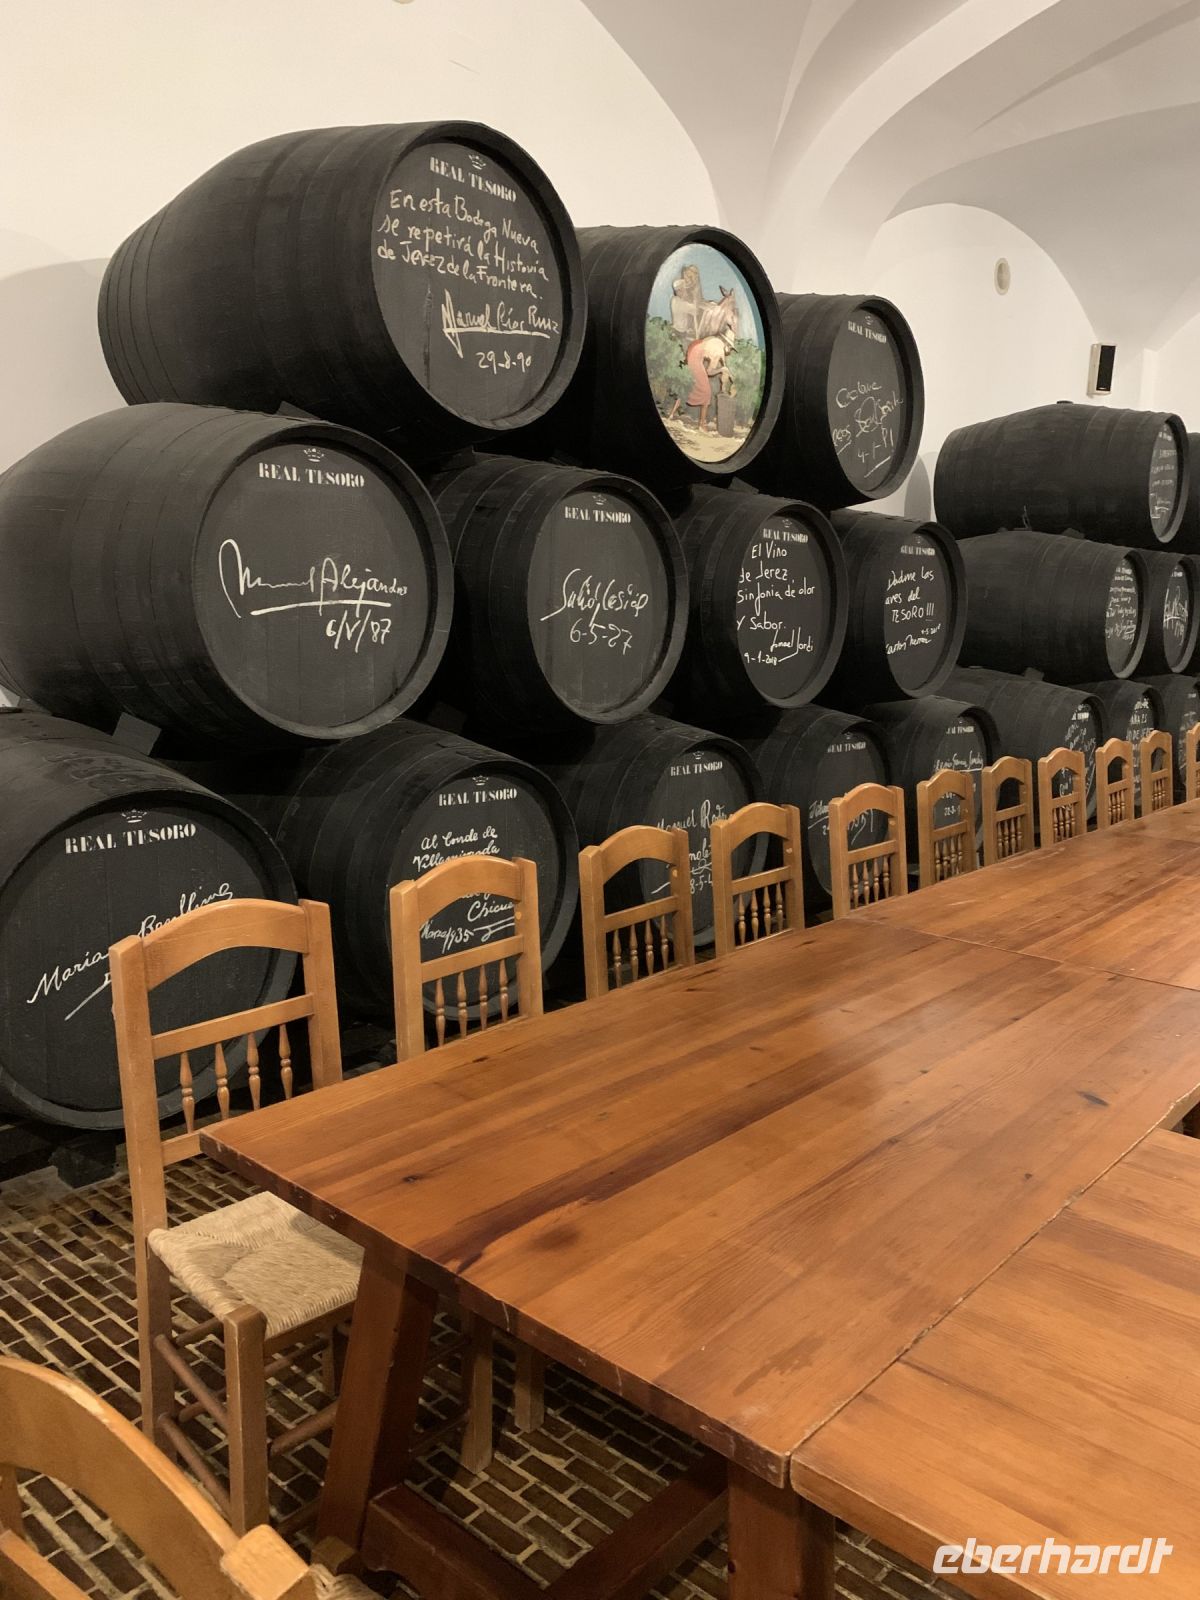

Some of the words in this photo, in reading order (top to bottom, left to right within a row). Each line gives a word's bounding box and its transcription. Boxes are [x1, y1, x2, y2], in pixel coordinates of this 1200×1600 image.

[429, 157, 465, 184] REAL
[467, 171, 517, 203] TESORO
[377, 214, 400, 237] se
[389, 189, 416, 211] En
[419, 187, 451, 218] esta
[454, 195, 498, 244] Bodega
[502, 218, 539, 255] Nueva
[377, 239, 396, 260] de
[400, 240, 446, 274] Jerez
[447, 259, 460, 277] de
[462, 260, 477, 284] la
[848, 320, 864, 336] REAL
[865, 326, 887, 344] TESORO
[258, 462, 301, 482] REAL
[305, 468, 365, 488] TESORO
[564, 506, 591, 521] REAL
[592, 509, 632, 524] TESORO
[762, 528, 781, 541] REAL
[783, 531, 809, 543] TESORO
[751, 543, 762, 559] El
[765, 541, 788, 559] Vino
[784, 584, 796, 598] de
[798, 577, 816, 596] olor
[670, 765, 691, 777] REAL
[693, 761, 723, 774] TESORO
[438, 791, 470, 807] REAL
[472, 788, 518, 803] TESORO
[65, 833, 118, 854] REAL
[122, 823, 197, 847] TESORO
[482, 825, 498, 839] de
[26, 951, 110, 1004] Maria
